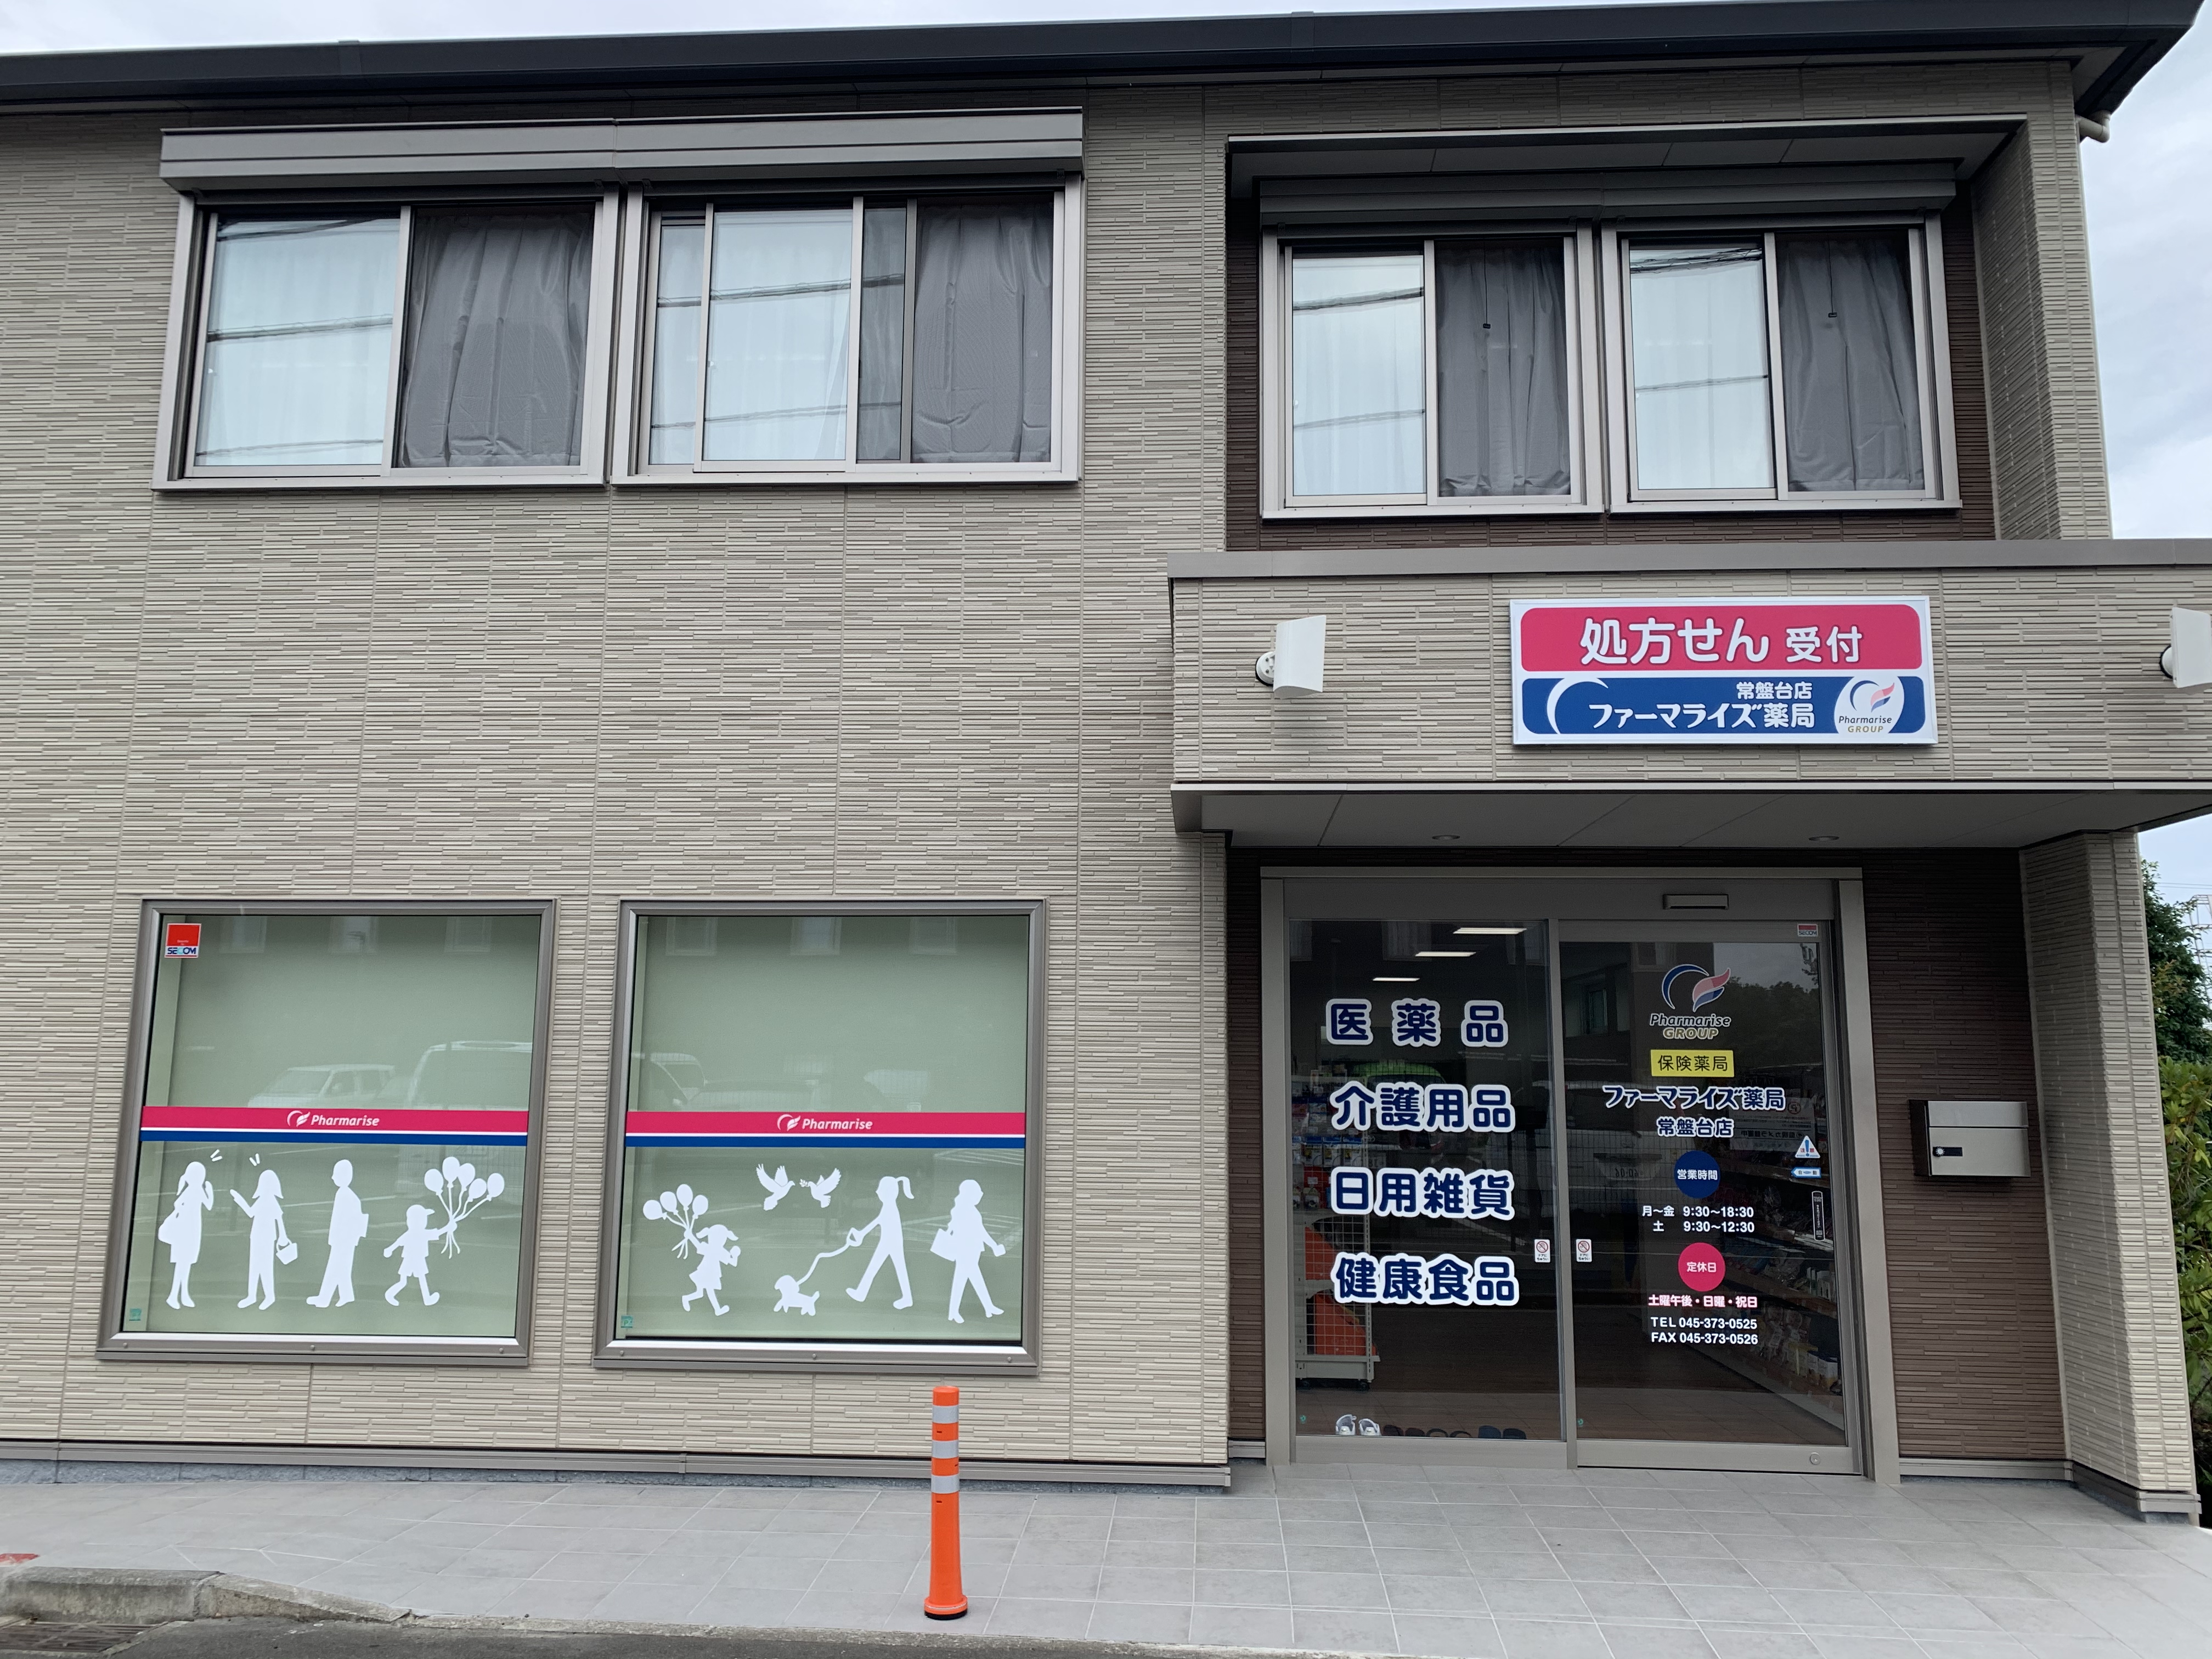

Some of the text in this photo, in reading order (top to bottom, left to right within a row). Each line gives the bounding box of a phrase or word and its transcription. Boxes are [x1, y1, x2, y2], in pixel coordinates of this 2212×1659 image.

[1580, 616, 1863, 665] 処方せん 受付
[1736, 681, 1813, 701] 常盤台店
[1588, 703, 1815, 730] ファーマライズ薬局
[1838, 715, 1892, 724] Pharmarise
[1329, 1001, 1506, 1045] 医薬品
[1650, 1013, 1731, 1027] Pharmarise
[1663, 1028, 1718, 1039] GROUP
[1657, 1054, 1728, 1071] 保険薬局
[1603, 1086, 1786, 1110] ファーマライズ薬局
[1333, 1084, 1513, 1130] 介護用品
[311, 1115, 380, 1126] Pharmarise
[802, 1119, 873, 1130] Pharmarise
[1657, 1118, 1734, 1137] 常盤台店
[1677, 1169, 1718, 1181] 営業時間
[1334, 1170, 1513, 1217] 日用雑貨
[1653, 1220, 1664, 1232] 土
[1686, 1262, 1717, 1273] 定休日
[1334, 1256, 1516, 1303] 健康食品
[1651, 1317, 1758, 1329] TEL 045-373-0525
[1651, 1332, 1758, 1345] FAX 045-373-0526
